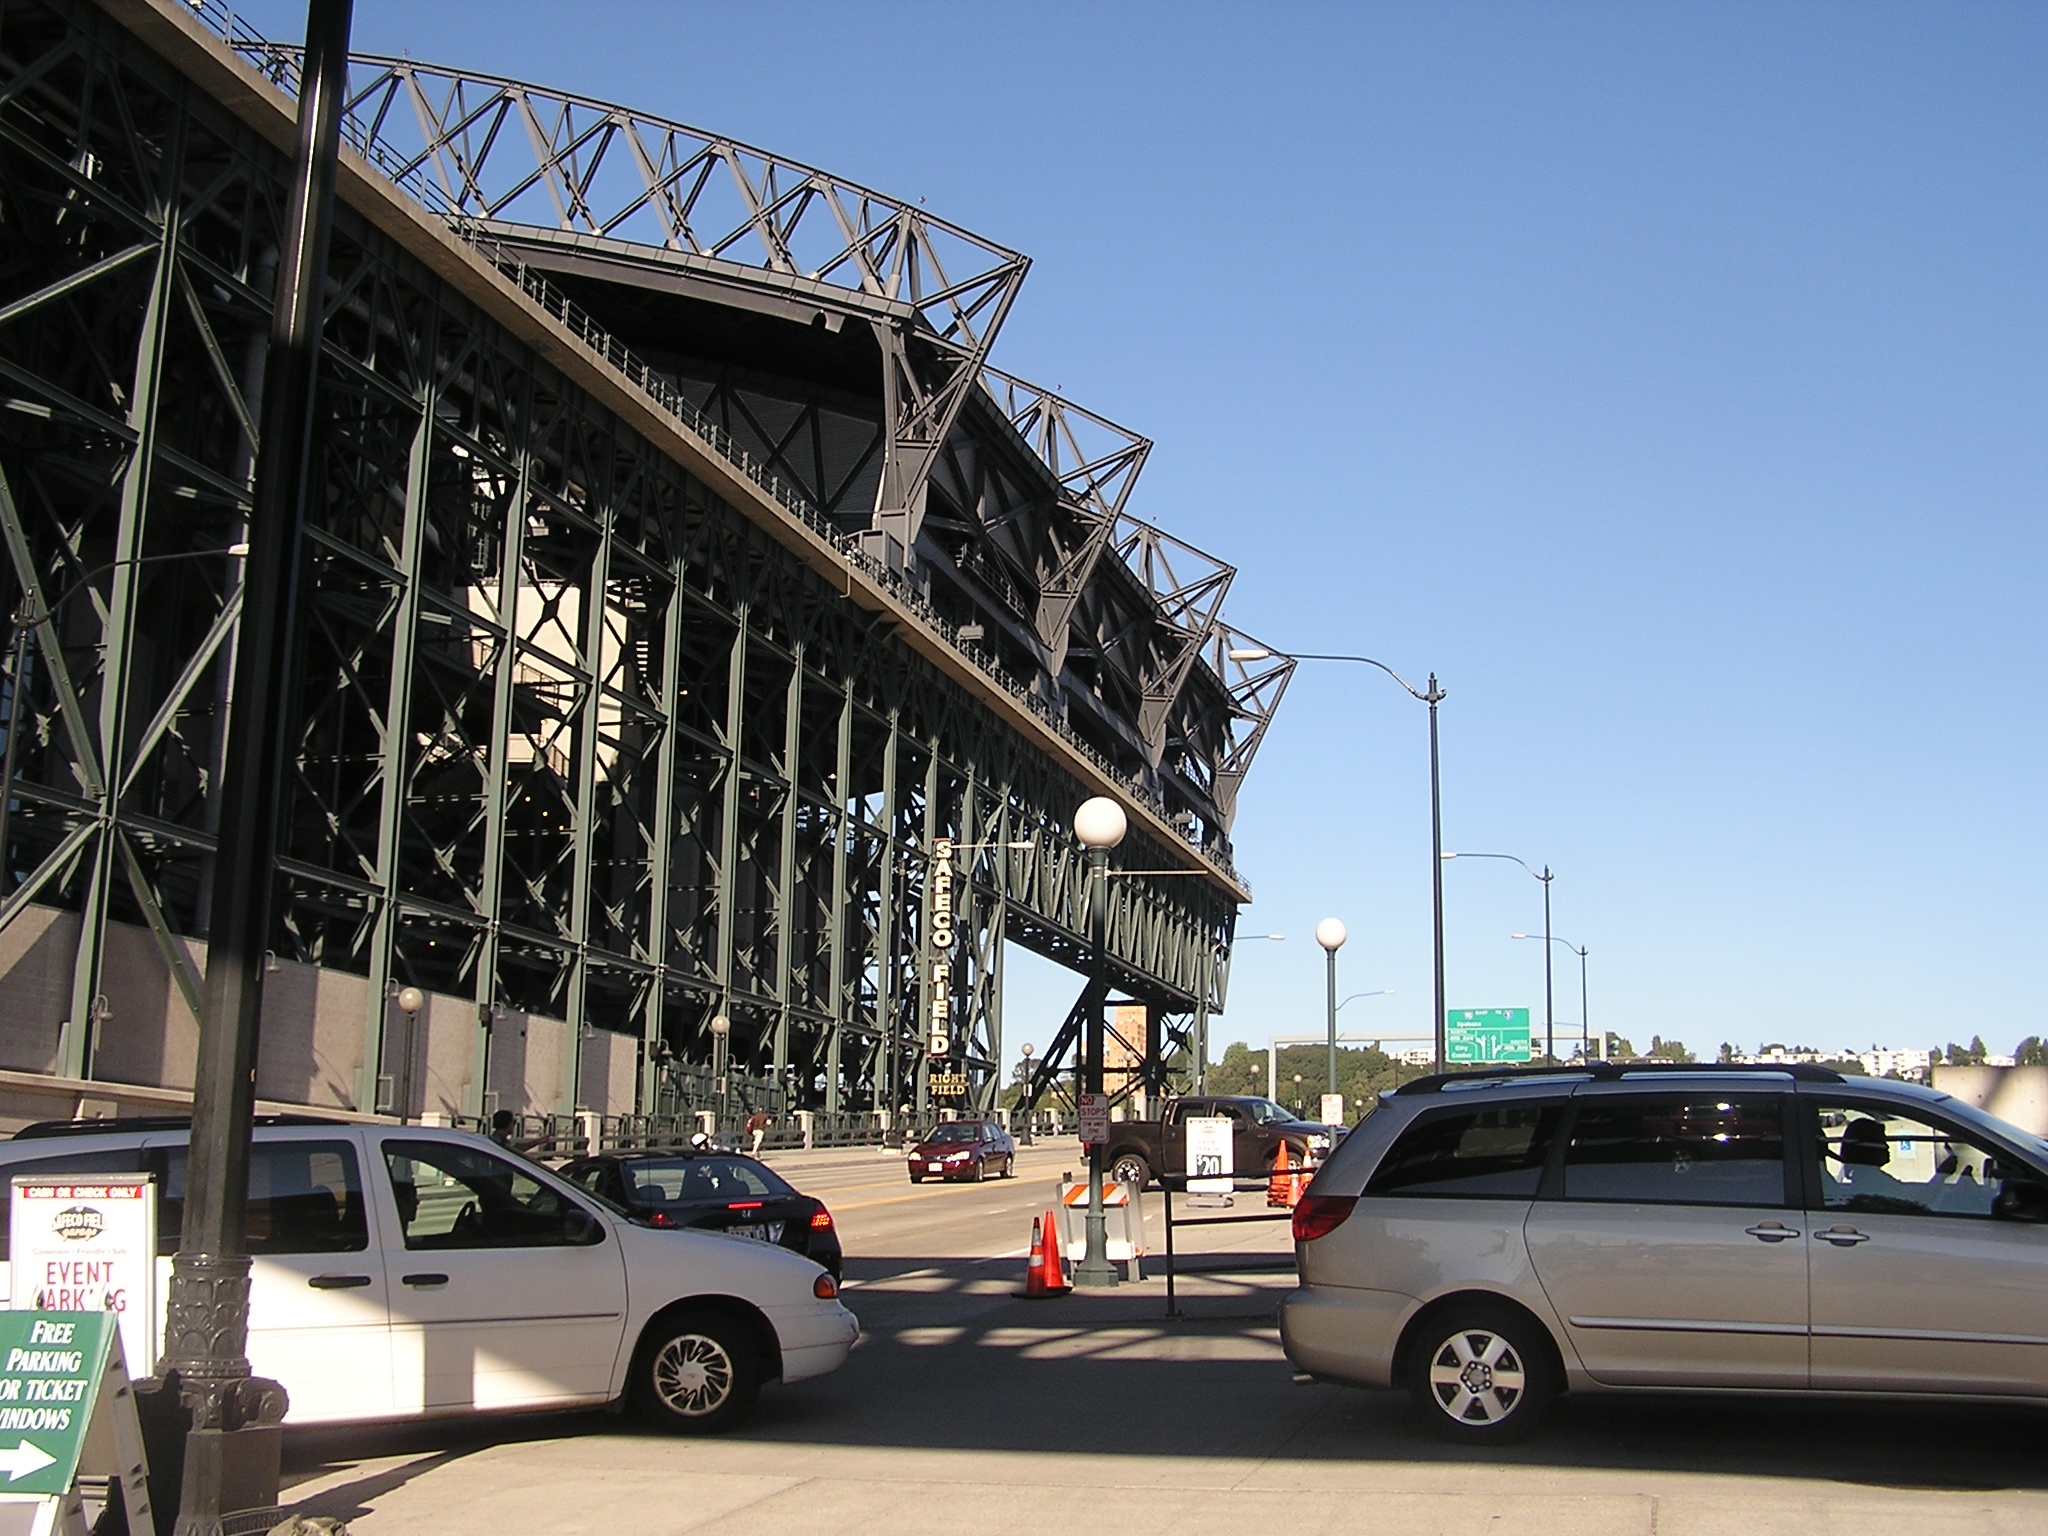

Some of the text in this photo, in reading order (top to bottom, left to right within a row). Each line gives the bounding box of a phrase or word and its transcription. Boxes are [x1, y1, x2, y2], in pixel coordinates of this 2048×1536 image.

[930, 841, 953, 1055] SAFECO FIELD
[929, 1073, 967, 1084] RIGHT
[931, 1085, 966, 1096] FIELD
[1081, 1096, 1093, 1105] NO
[1081, 1107, 1106, 1116] STOPS
[1197, 1155, 1219, 1175] $20
[28, 1186, 137, 1197] CASH OR CHECK ONLY
[46, 1261, 114, 1285] EVENT
[44, 1288, 127, 1312] ARKG
[29, 1320, 76, 1344] FREE
[5, 1347, 83, 1373] PARKING
[25, 1379, 88, 1401] TICKET
